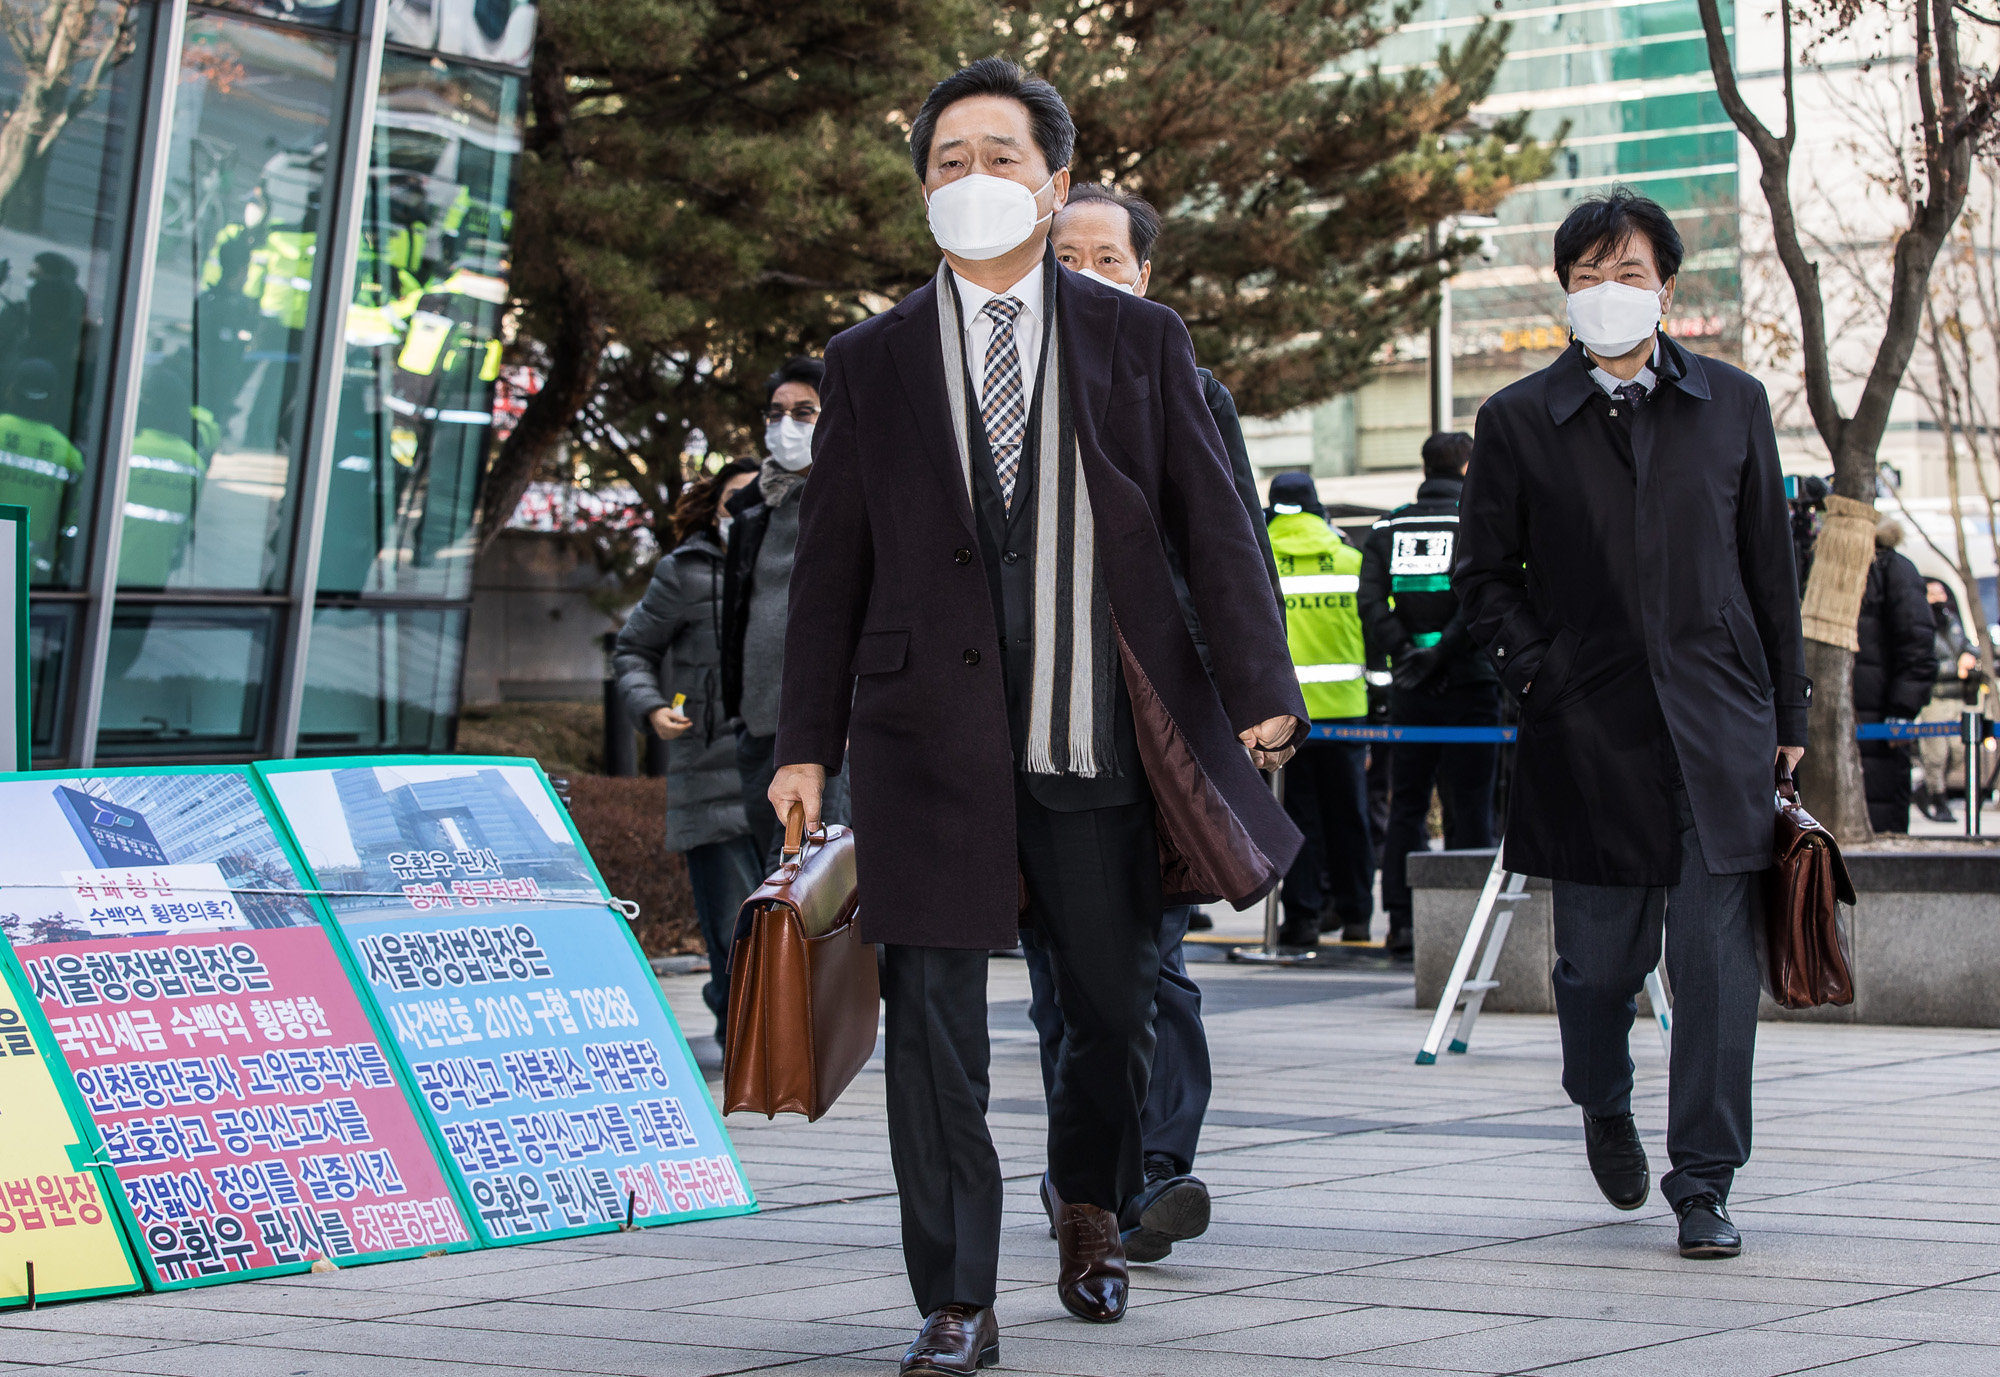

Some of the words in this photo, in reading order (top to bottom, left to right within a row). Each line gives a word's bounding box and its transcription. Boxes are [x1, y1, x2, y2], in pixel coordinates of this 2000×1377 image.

[1285, 595, 1352, 610] OLICE
[389, 851, 455, 878] 유환우
[455, 849, 502, 875] 판사
[403, 883, 453, 910] 징계
[452, 878, 545, 907] 청구하라!
[89, 905, 148, 928] 수백억
[150, 900, 236, 925] 횡령의혹?
[29, 944, 272, 1006] 서울행정법원장은
[359, 924, 553, 992] 서울행정법원장은
[0, 1008, 36, 1057] 을
[51, 1009, 166, 1057] 국민세금
[170, 1002, 252, 1047] 수백억
[250, 996, 332, 1042] 횡령한
[390, 997, 483, 1050] 사건번호
[475, 994, 534, 1039] 2019
[527, 988, 580, 1036] 구합
[570, 985, 639, 1030] 79268
[76, 1057, 242, 1114] 인천항만공사
[241, 1044, 394, 1095] 고위공직자를
[413, 1056, 511, 1112] 공익신고
[501, 1048, 593, 1100] 처분취소
[584, 1039, 669, 1094] 위법부당
[100, 1114, 218, 1168] 보호하고
[213, 1098, 373, 1156] 공익신고자를
[441, 1119, 521, 1174] 판결로
[509, 1103, 639, 1165] 공익신고자를
[629, 1097, 699, 1150] 괴롭힌
[123, 1169, 215, 1225] 짓밟아
[213, 1160, 302, 1211] 정의를
[300, 1149, 405, 1200] 실종시킨
[470, 1171, 551, 1237] 유환우
[547, 1166, 627, 1228] 판사를
[615, 1163, 670, 1216] 징계
[658, 1155, 750, 1211] 청구하라!
[147, 1215, 256, 1281] 유환우
[255, 1203, 356, 1265] 판사를
[353, 1198, 470, 1250] 처벌하라!
